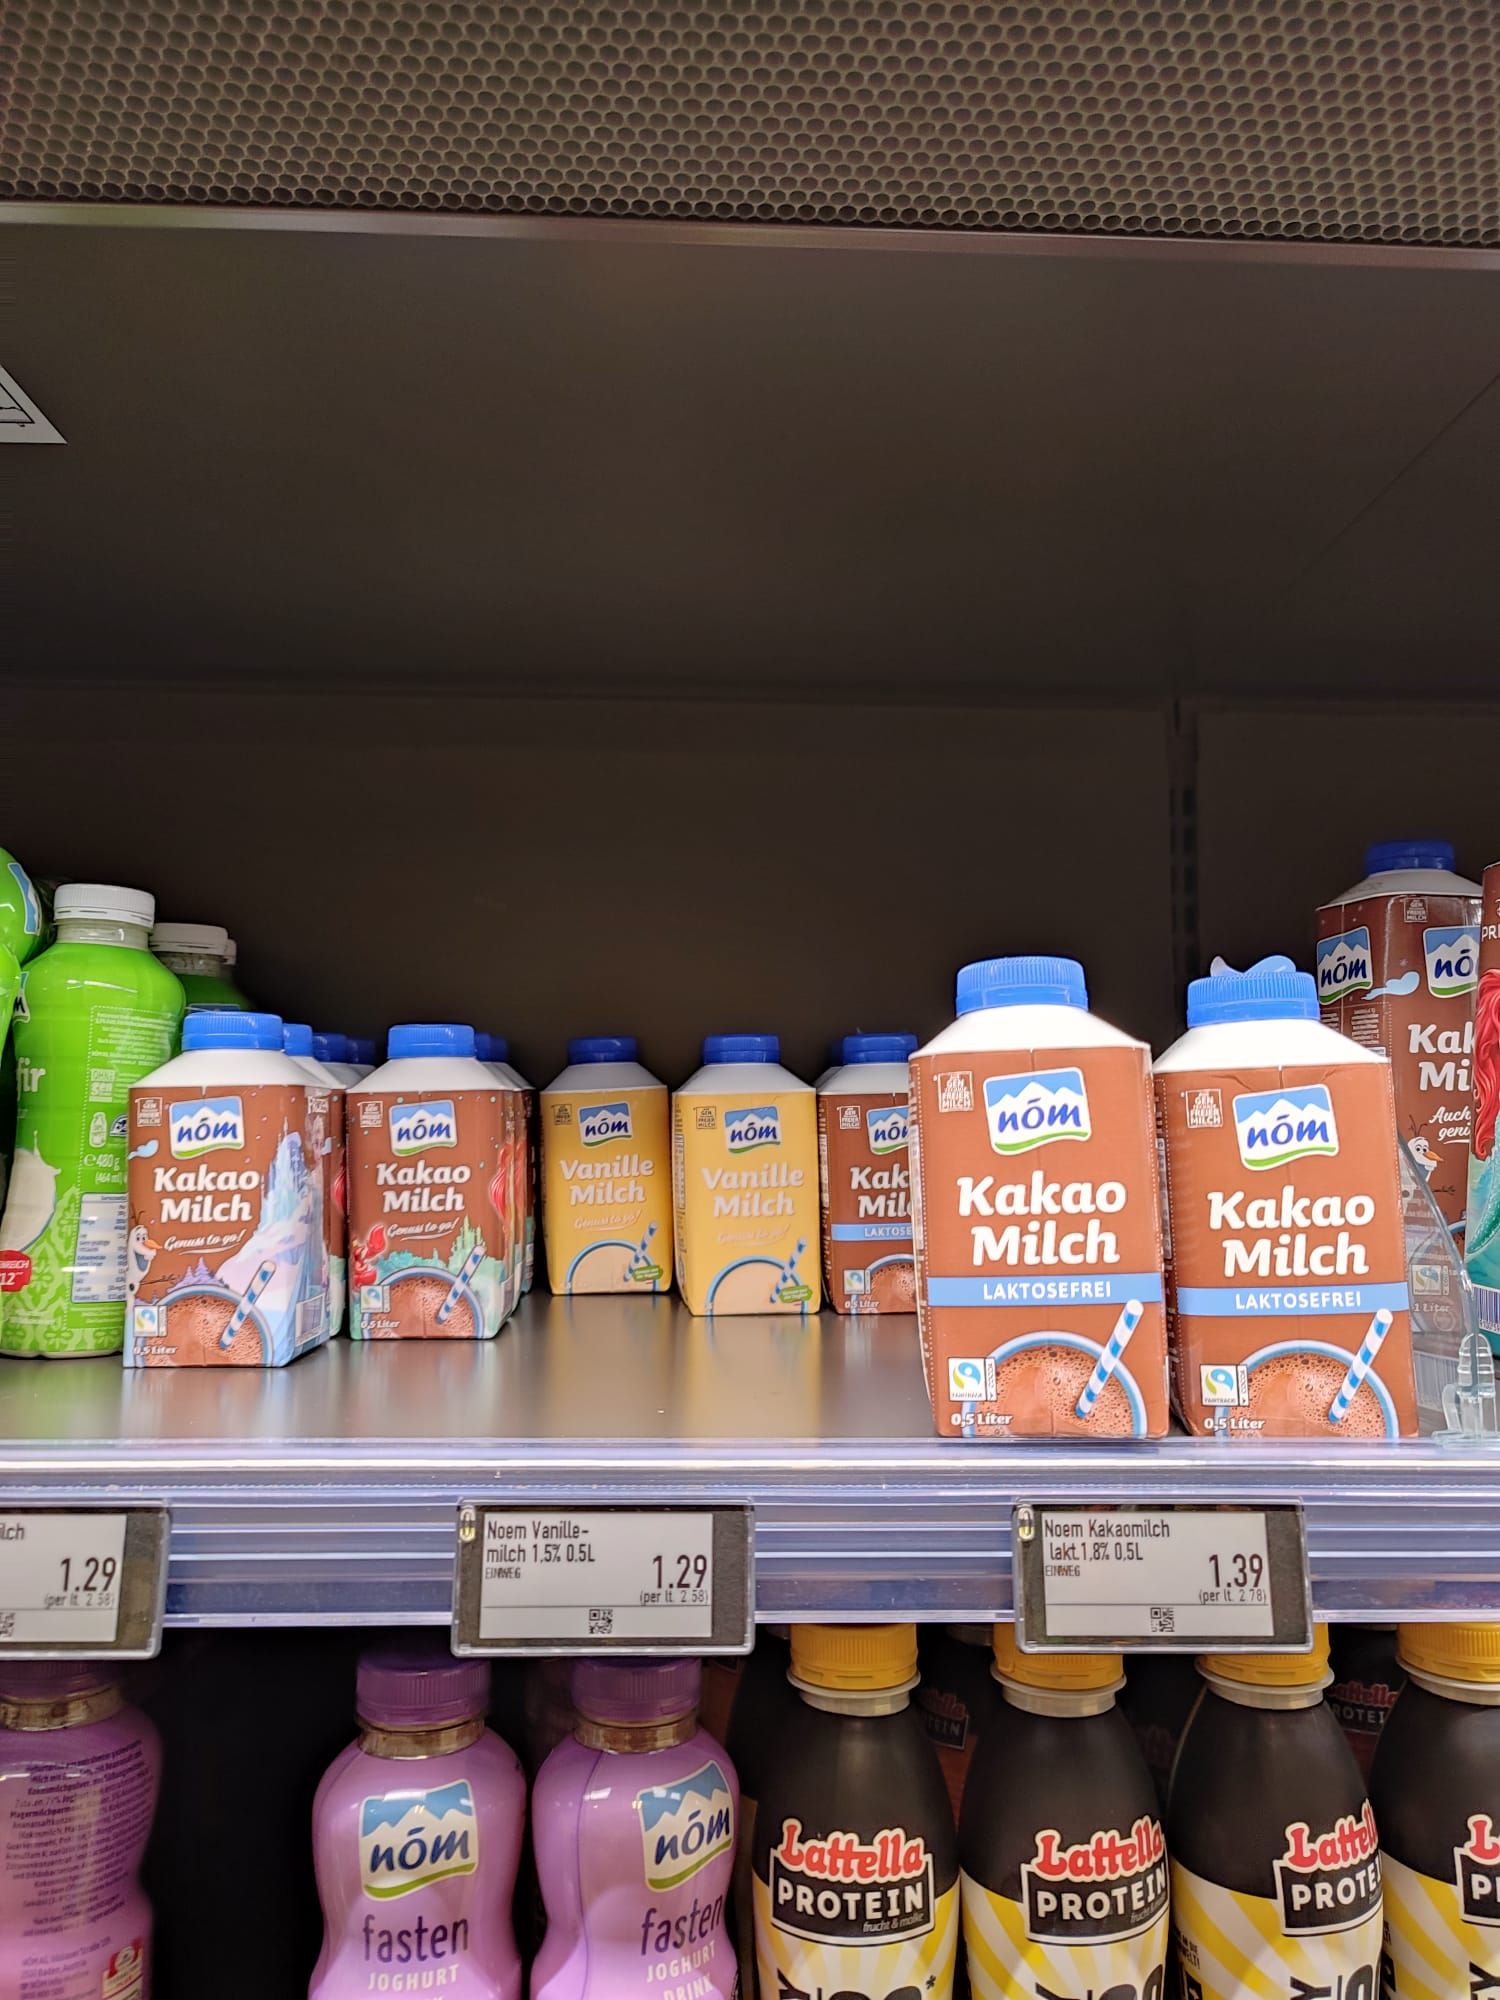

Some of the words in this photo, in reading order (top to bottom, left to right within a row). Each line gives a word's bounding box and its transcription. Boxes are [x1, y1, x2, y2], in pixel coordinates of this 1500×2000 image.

[1407, 1021, 1475, 1054] Kak
[153, 1163, 260, 1193] Kakao
[376, 1160, 471, 1185] Kakao
[559, 1153, 655, 1181] Vanille
[701, 1161, 804, 1191] Vanille
[850, 1163, 911, 1190] Kak
[383, 1186, 465, 1213] Milch
[570, 1180, 646, 1206] Milch
[713, 1191, 795, 1218] Milch
[957, 1169, 1126, 1217] Kakao
[160, 1194, 253, 1223] Milch
[1207, 1185, 1375, 1231] Kakao
[864, 1227, 912, 1237] LAKTOSE
[971, 1218, 1121, 1267] Milch
[1221, 1231, 1370, 1279] Milch
[983, 1280, 1112, 1301] LAKTOSEFREI
[1235, 1290, 1362, 1310] LAKTOSEFREI
[951, 1413, 975, 1428] 0,5
[977, 1412, 1014, 1425] Liter
[1204, 1417, 1227, 1431] 0,5
[1230, 1417, 1265, 1430] Liter
[487, 1521, 527, 1539] Noem
[533, 1520, 589, 1539] Vanille-
[1045, 1519, 1083, 1537] Noem
[1089, 1518, 1170, 1538] Kakaomilch
[487, 1544, 525, 1563] milch
[60, 1557, 117, 1592] 1.29
[485, 1567, 521, 1579] EINWEG
[653, 1555, 708, 1589] 1.29
[1045, 1565, 1081, 1577] EINWEG
[1209, 1554, 1264, 1588] 1.39
[779, 1819, 926, 1880] Lattella
[1035, 1816, 1164, 1881] Lattella
[1286, 1800, 1379, 1872] Lattell
[778, 1878, 923, 1920] PROTEIN
[1036, 1861, 1166, 1921] PROTEIN
[1291, 1858, 1382, 1912] PROTEI
[363, 1914, 468, 1963] fasten
[641, 1894, 723, 1956] fasten
[863, 1919, 891, 1933] frucht
[646, 1940, 715, 1983] JOGHURT
[367, 1964, 459, 1991] JOGHURT
